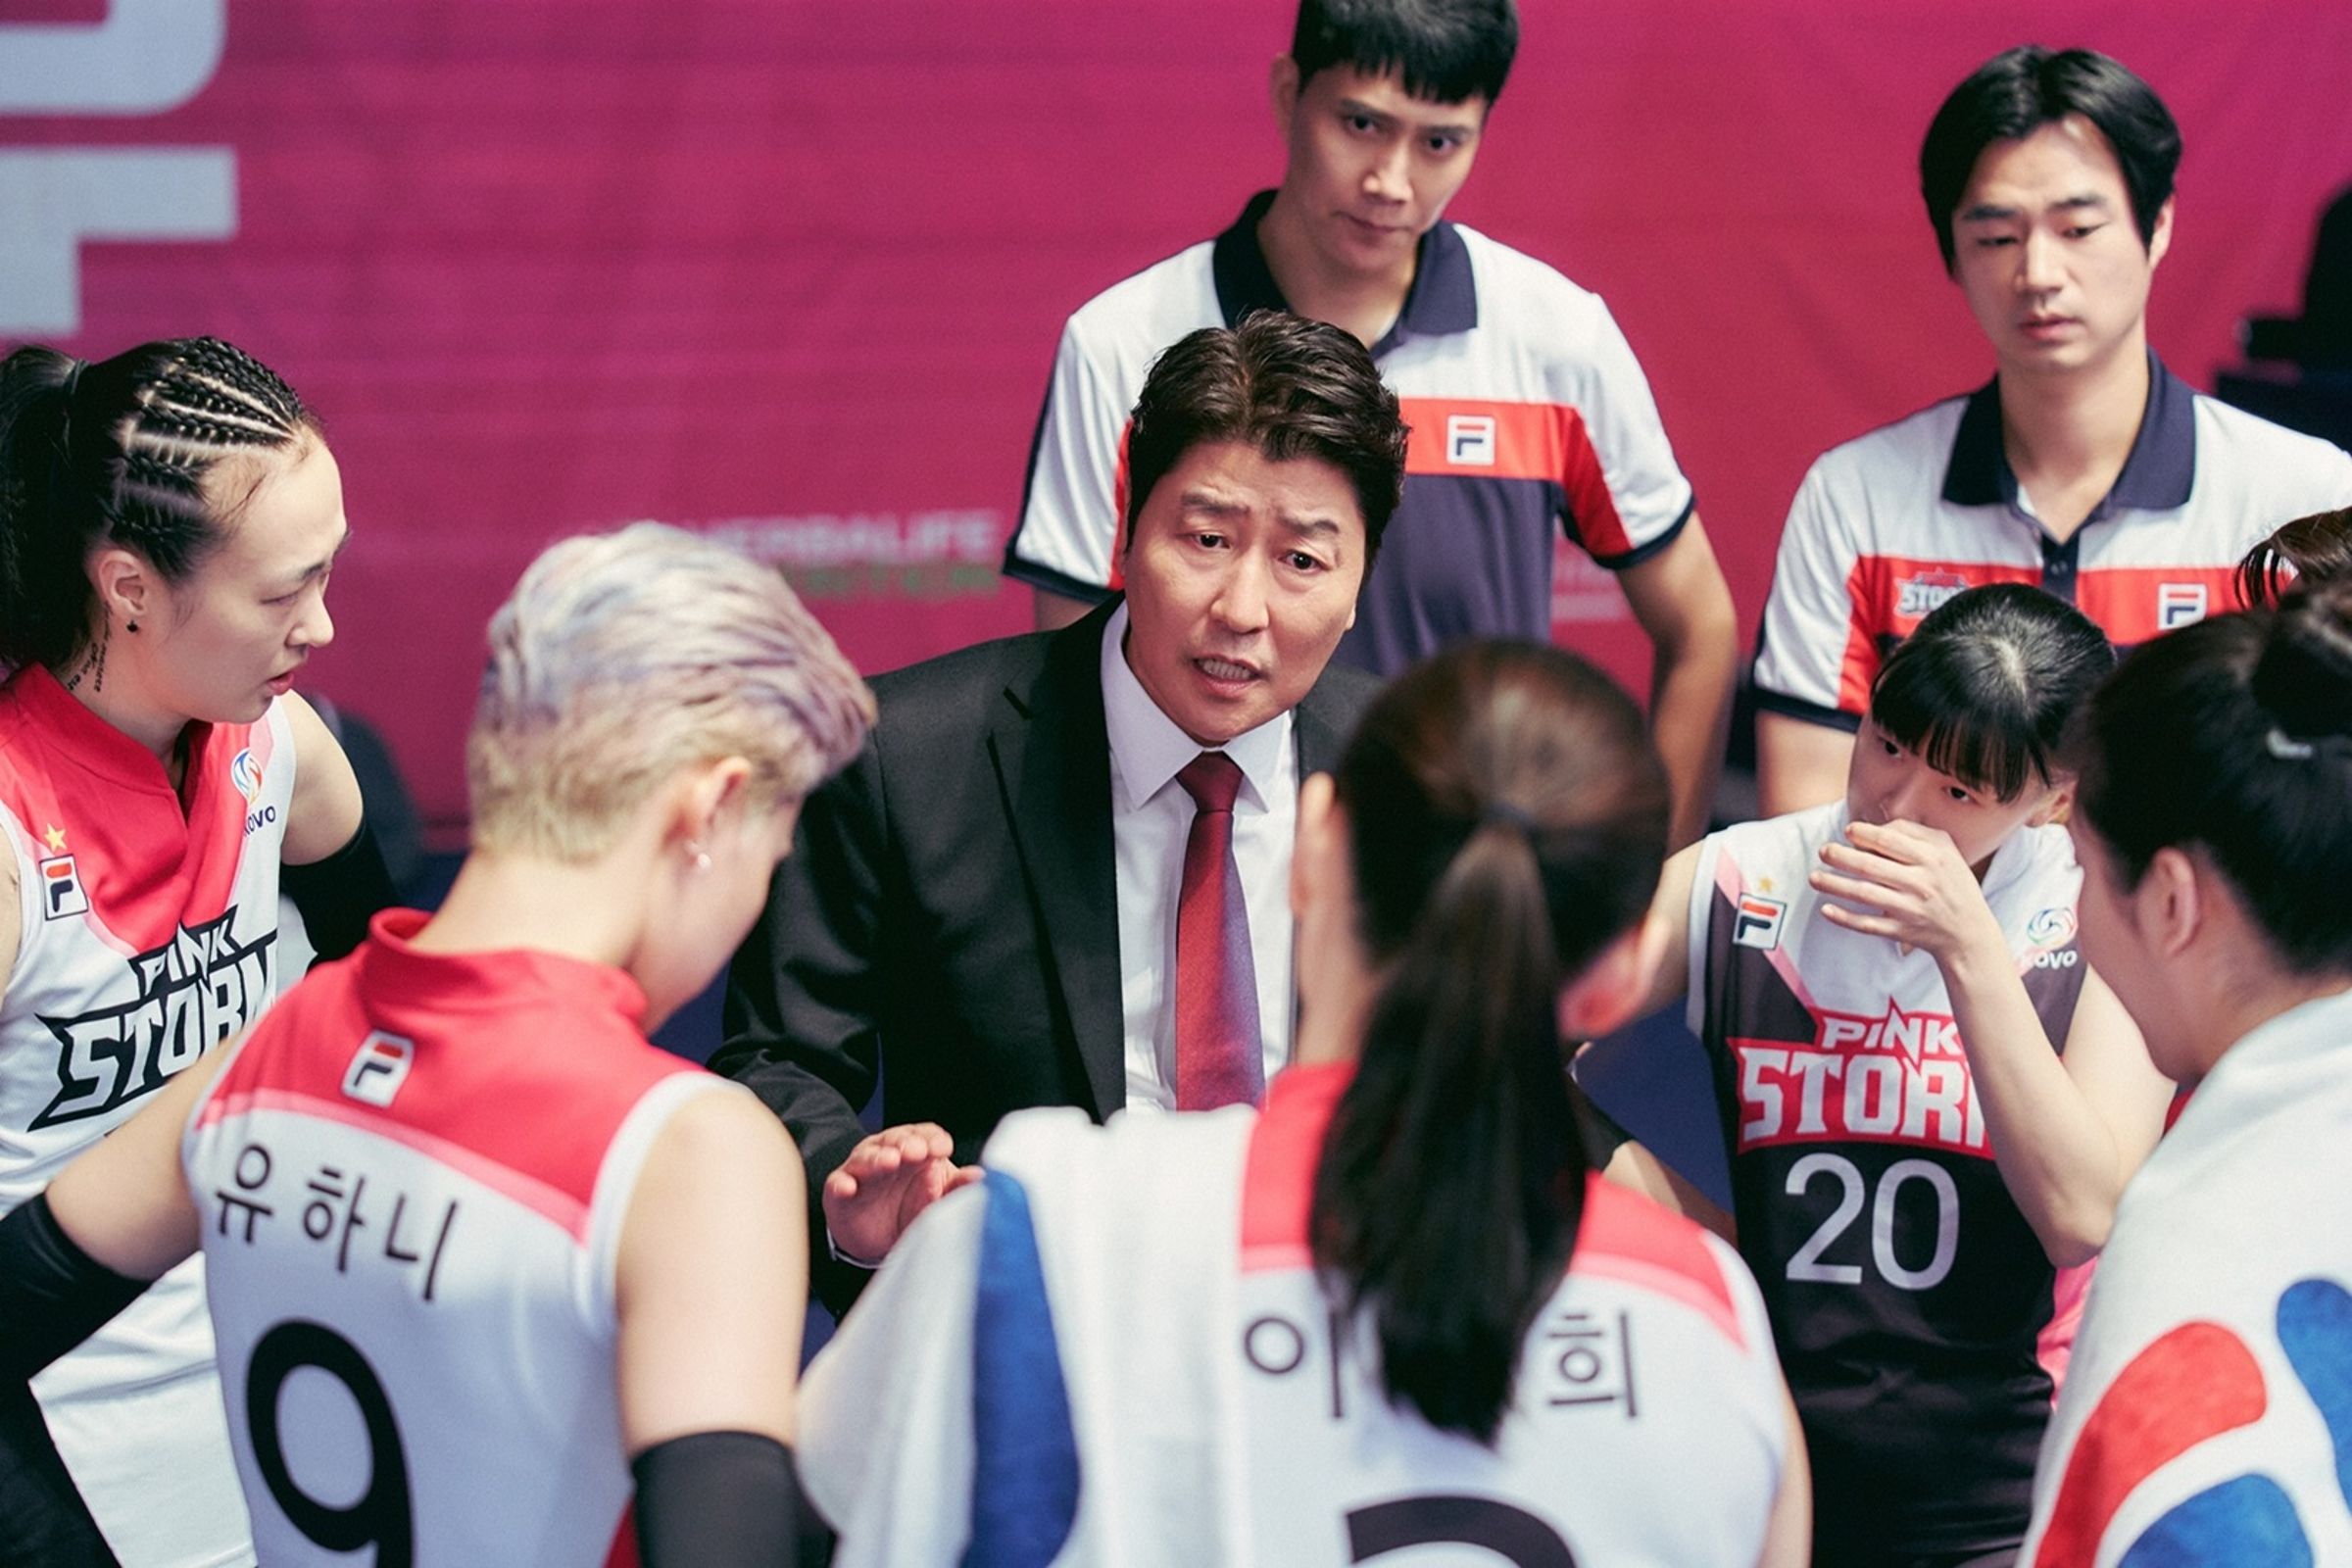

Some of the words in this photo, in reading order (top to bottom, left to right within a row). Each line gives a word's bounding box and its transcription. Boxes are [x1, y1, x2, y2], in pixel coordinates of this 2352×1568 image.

[1899, 582, 1964, 613] STO
[244, 806, 276, 837] OVO
[138, 918, 236, 998] PINK
[2025, 950, 2079, 970] OVO
[1822, 1007, 1962, 1064] PINK
[216, 1143, 459, 1301] 유하니
[1785, 1152, 1960, 1291] 20
[1244, 1309, 1637, 1419] 이희
[245, 1317, 414, 1568] 9
